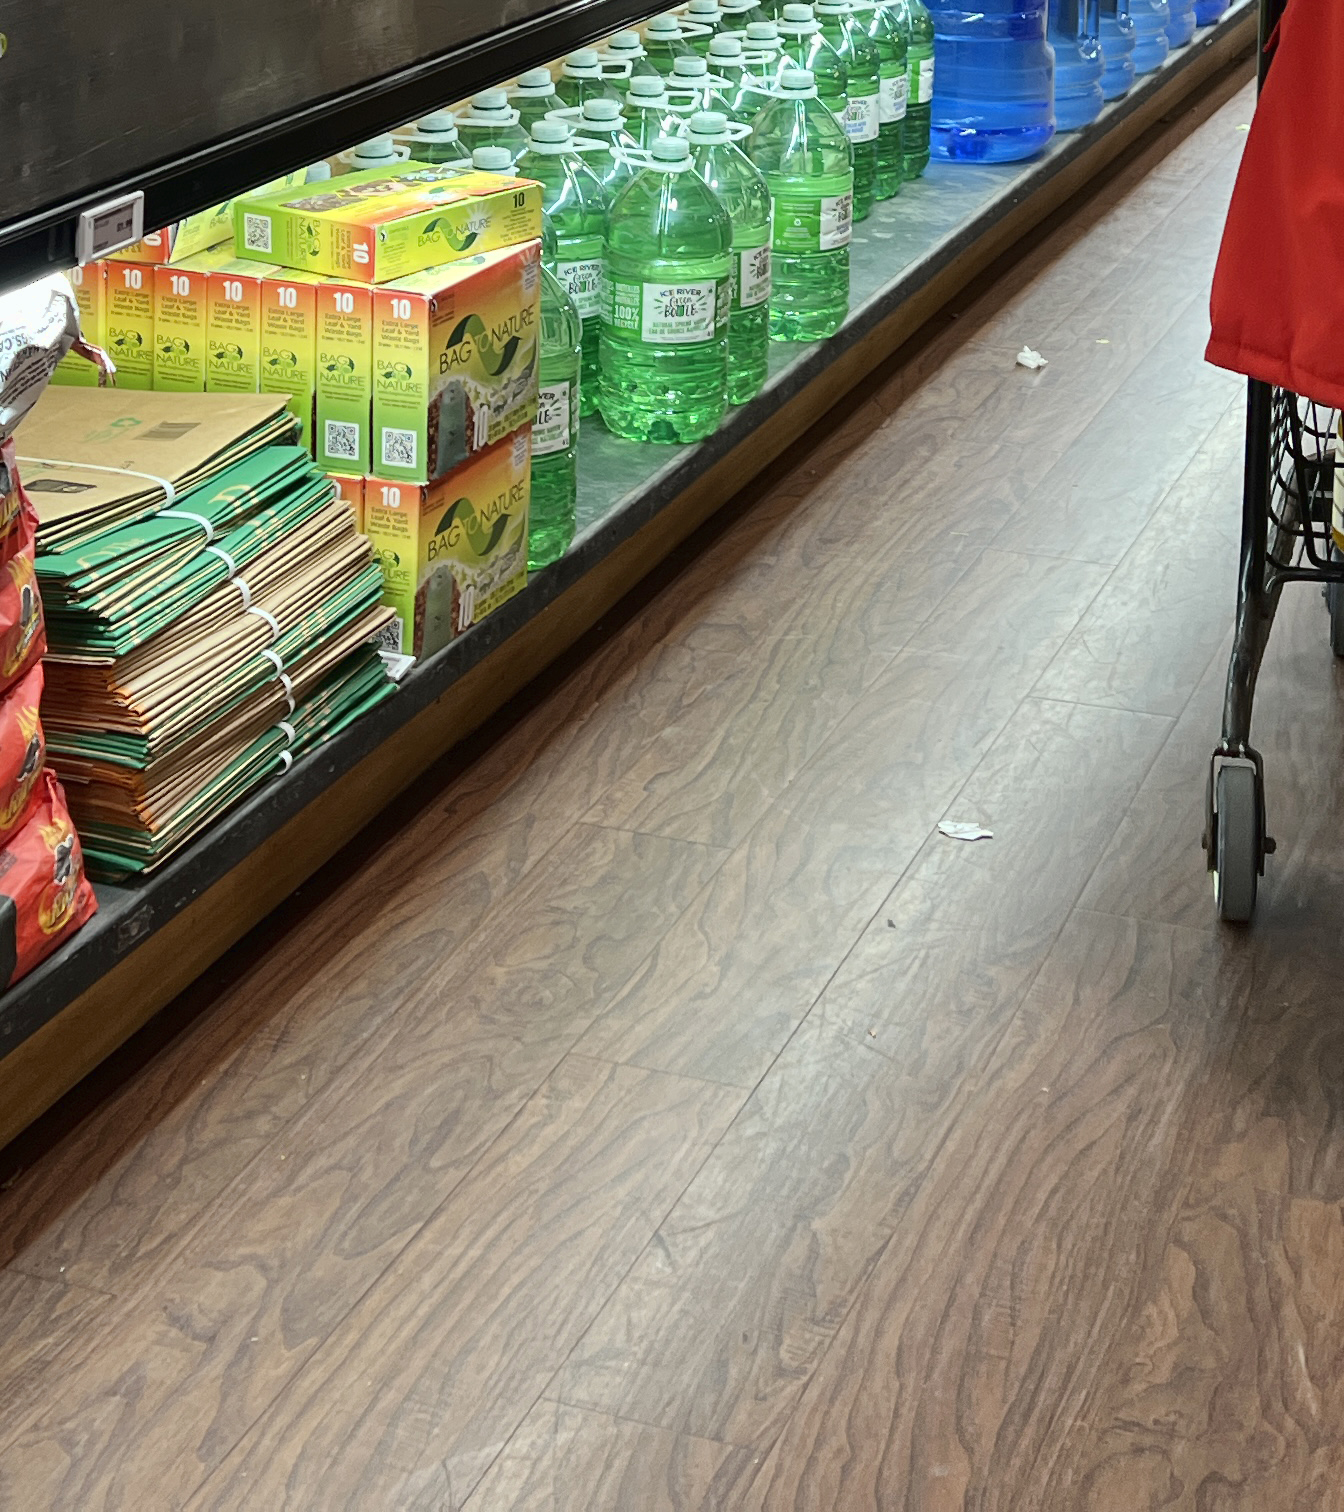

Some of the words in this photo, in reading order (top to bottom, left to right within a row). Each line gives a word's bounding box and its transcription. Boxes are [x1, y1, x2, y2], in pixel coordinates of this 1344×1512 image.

[513, 191, 525, 208] 10
[417, 230, 441, 248] BAG
[455, 216, 492, 235] NATURE
[353, 242, 370, 264] 10
[122, 268, 142, 289] 10
[170, 275, 190, 296] 10
[223, 280, 243, 302] 10
[277, 287, 297, 308] 10
[660, 289, 675, 298] ICE
[676, 288, 702, 297] RIVER
[333, 292, 354, 313] 10
[390, 298, 411, 320] 10
[614, 304, 640, 320] 100%
[109, 327, 136, 338] BAG
[156, 334, 184, 346] BAG
[439, 340, 472, 375] BAG
[490, 304, 534, 341] NATURE
[108, 346, 153, 360] NATURE
[209, 340, 236, 352] BAG
[263, 346, 291, 359] BAG
[156, 353, 200, 368] NATURE
[209, 359, 253, 373] NATURE
[320, 353, 348, 365] BAG
[377, 359, 407, 372] BAG
[262, 367, 307, 380] NATURE
[320, 372, 366, 386] NATURE
[376, 379, 422, 393] NATURE
[472, 404, 489, 451] 10
[380, 486, 400, 508] 10
[427, 525, 461, 562] BAG
[478, 479, 525, 523] NATURE
[374, 548, 395, 561] AG
[458, 587, 475, 632] 10
